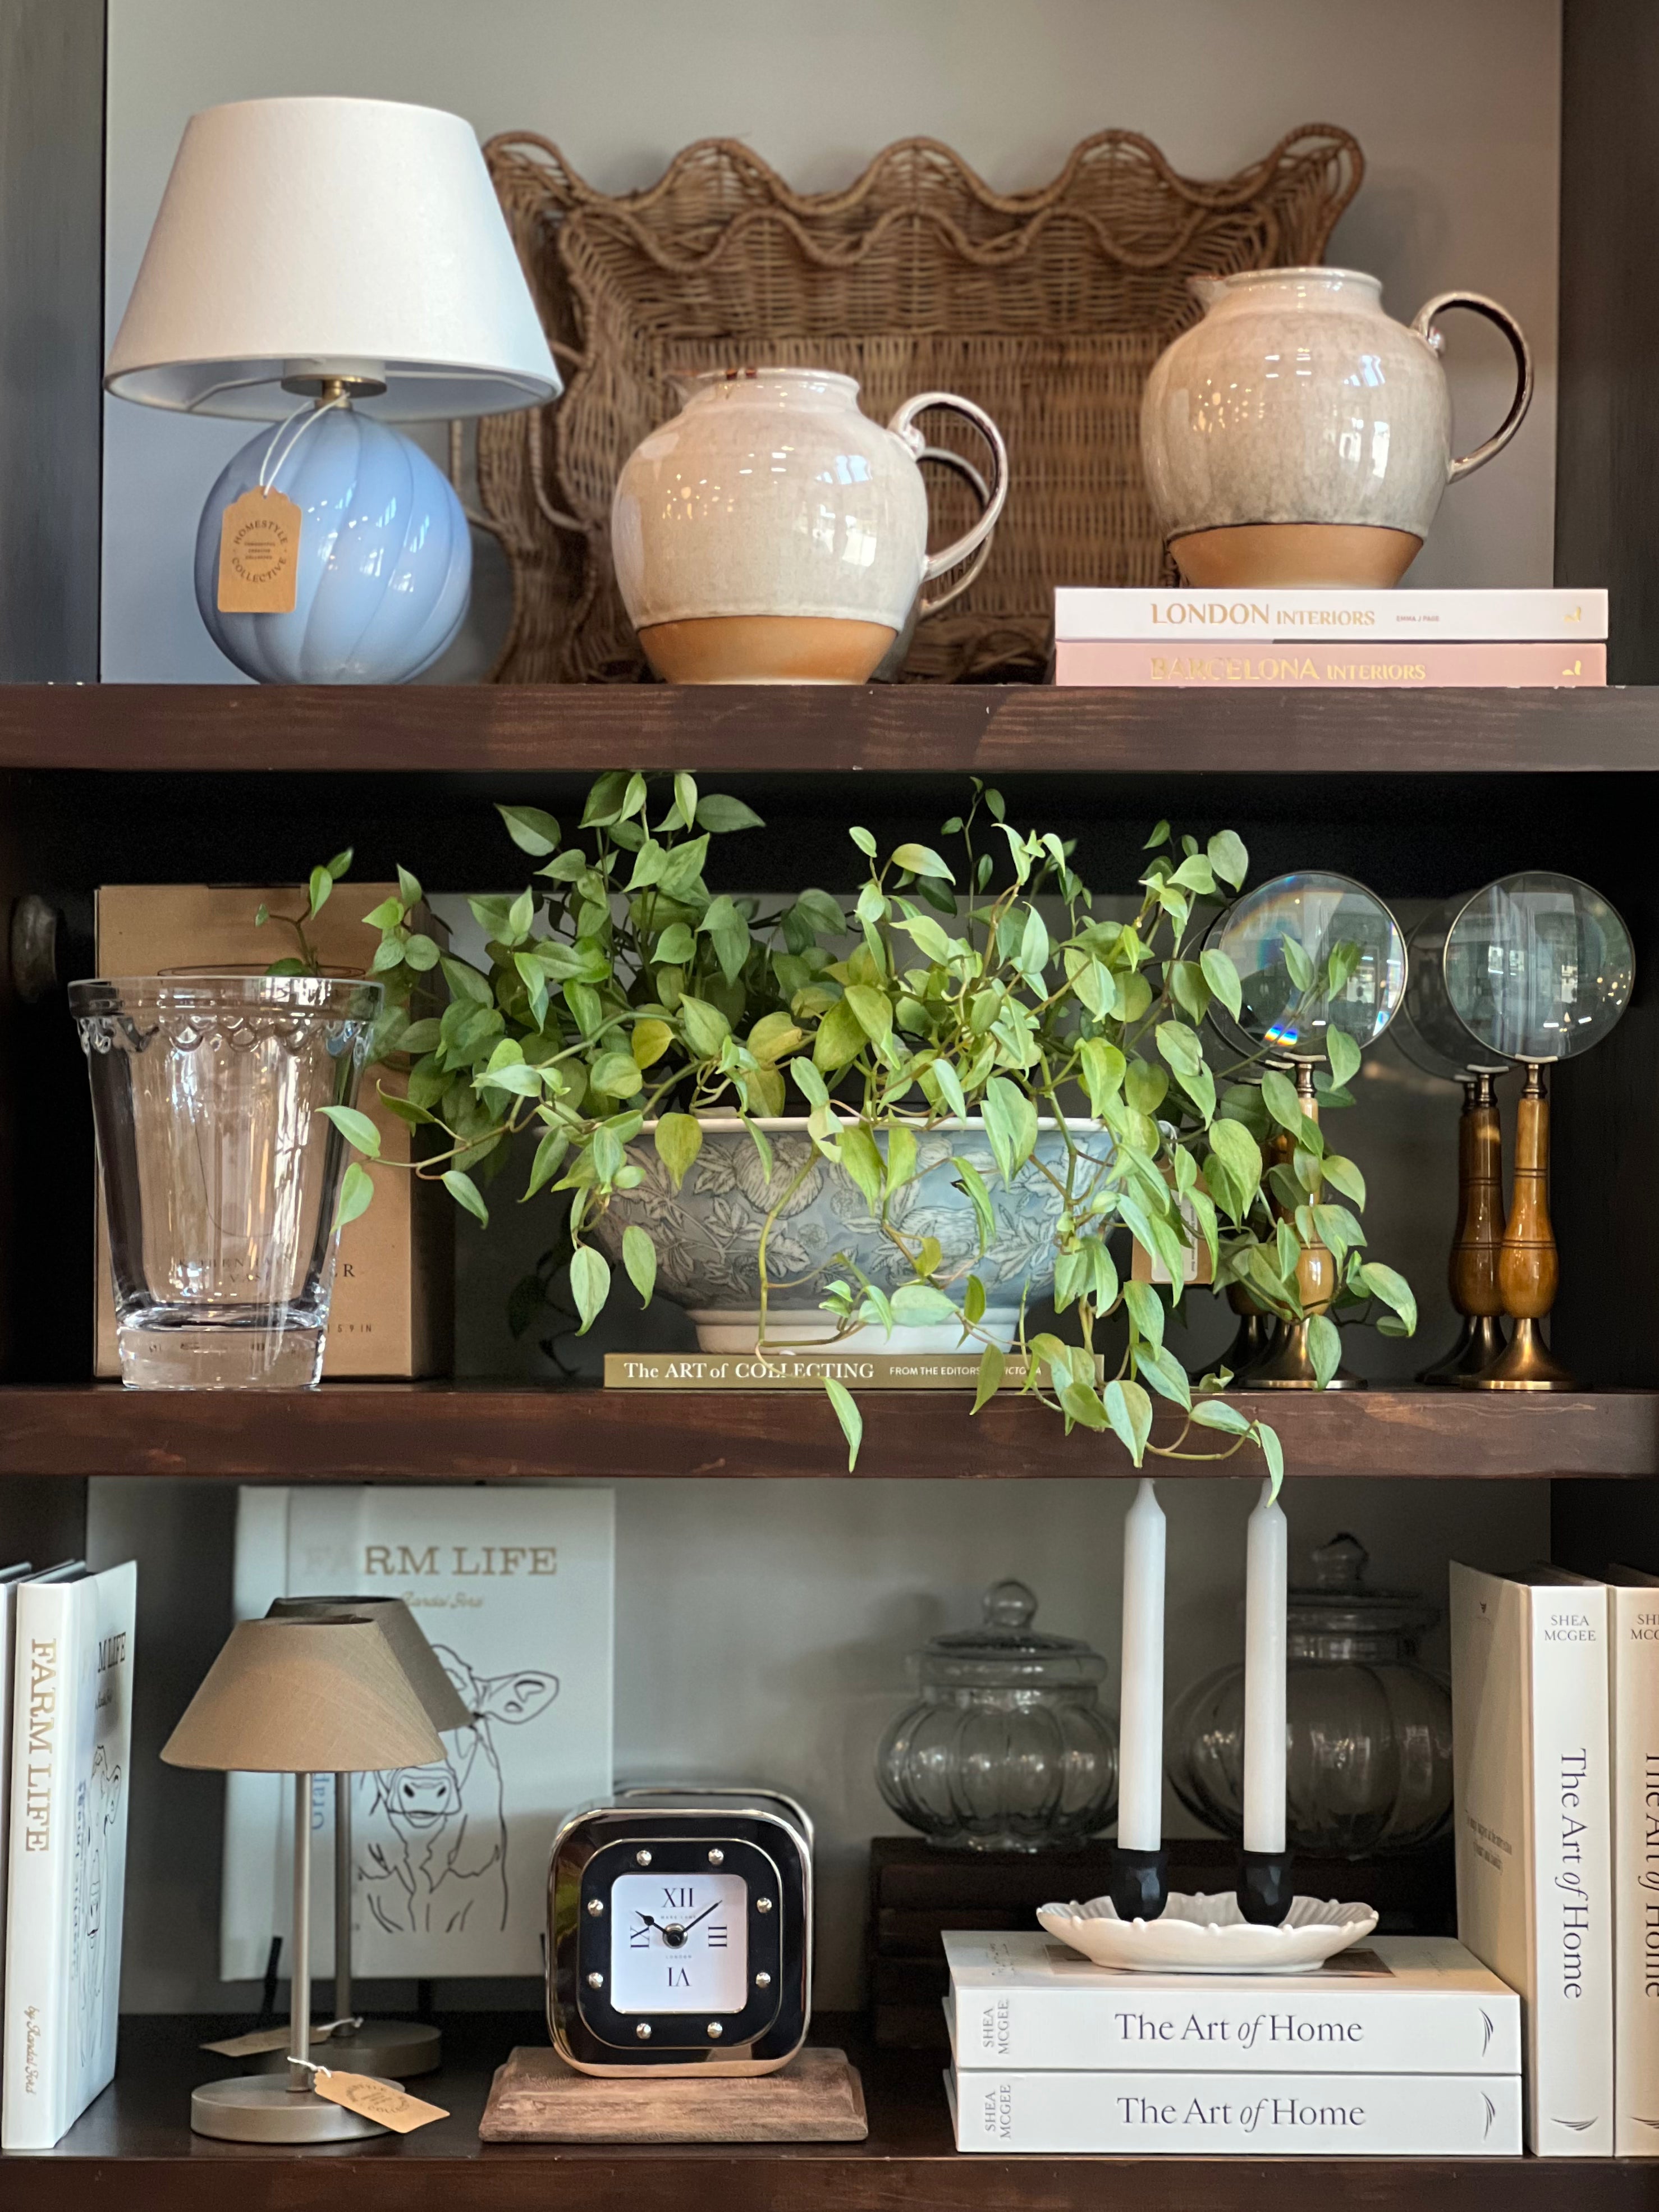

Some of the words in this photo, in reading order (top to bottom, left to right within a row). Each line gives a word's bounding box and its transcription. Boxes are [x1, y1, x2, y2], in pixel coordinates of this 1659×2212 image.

[233, 520, 288, 544] HOMESTYLE
[231, 556, 286, 583] COLLECTIVE
[1151, 603, 1268, 624] LONDON
[1277, 611, 1374, 625] INTERIORS
[1151, 657, 1319, 680] BARCELONA
[1327, 665, 1426, 680] INTERIORS
[624, 1363, 658, 1377] The
[665, 1363, 707, 1377] ART
[710, 1363, 728, 1377] of
[736, 1363, 874, 1378] COLLECTING
[1003, 1366, 1042, 1375] ICTOA
[452, 1547, 558, 1575] LIFE
[1551, 1615, 1589, 1625] SHEA
[1545, 1631, 1596, 1641] MCGEE
[29, 1639, 56, 1754] FARM
[1562, 1748, 1586, 1807] The
[26, 1764, 50, 1851] LIFE
[1562, 1815, 1587, 1863] Art
[662, 1888, 693, 1907] XII
[1555, 1872, 1588, 1901] of
[708, 1926, 727, 1947] III
[1564, 1906, 1588, 1998] Home
[667, 1967, 691, 1986] VI
[24, 2006, 39, 2019] by
[983, 2008, 993, 2047] SHEA
[998, 2001, 1008, 2054] MCGEE
[1115, 2014, 1173, 2040] The
[1181, 2014, 1228, 2040] Art
[1238, 2015, 1266, 2049] of
[1271, 2016, 1362, 2041] Home
[985, 2091, 996, 2131] SHEA
[1000, 2085, 1010, 2138] MCGEE
[1117, 2098, 1175, 2123] The
[1184, 2099, 1231, 2124] Art
[1240, 2099, 1268, 2132] of
[1273, 2099, 1364, 2125] Home
